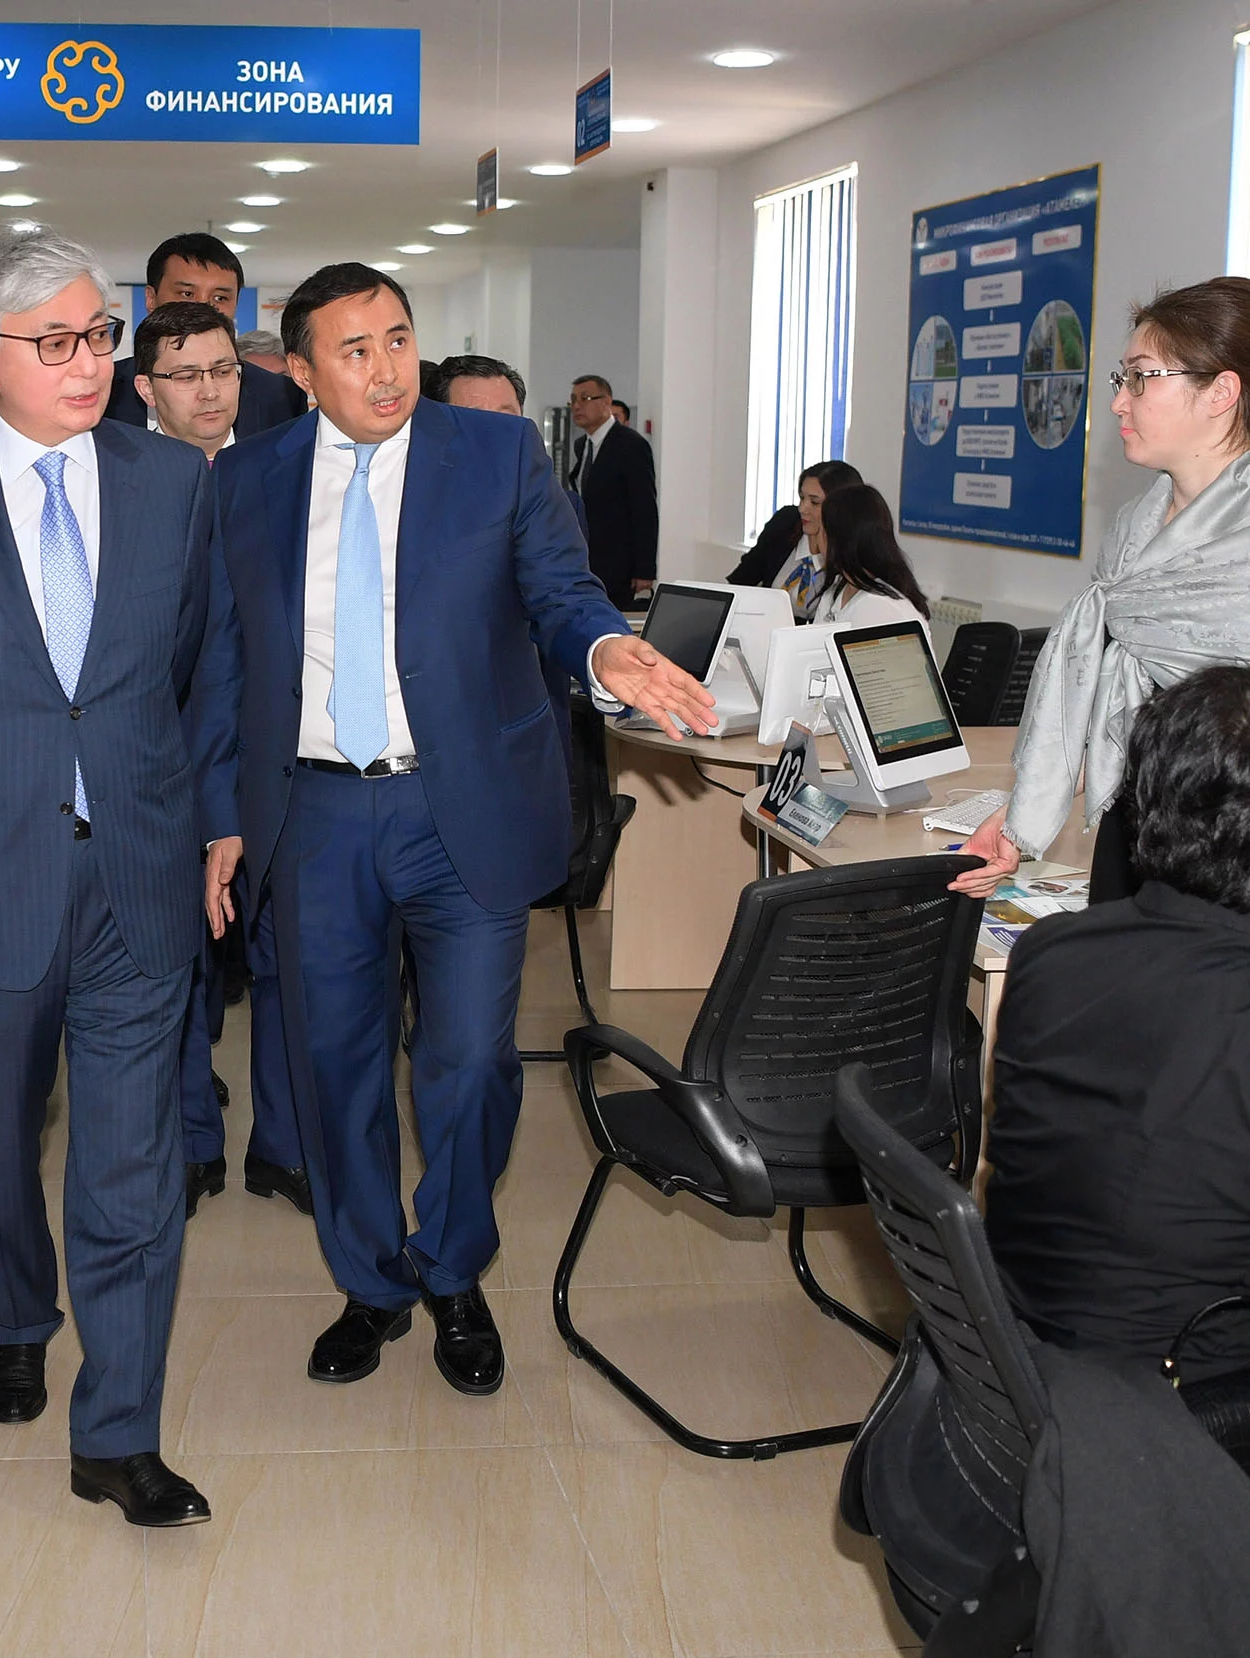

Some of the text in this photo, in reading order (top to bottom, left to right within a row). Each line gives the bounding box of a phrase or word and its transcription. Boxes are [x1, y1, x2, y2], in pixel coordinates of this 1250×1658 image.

[236, 60, 305, 83] ЗОНА
[145, 90, 393, 115] ФИНАНСИРОВАНИЯ
[769, 751, 802, 807] 03
